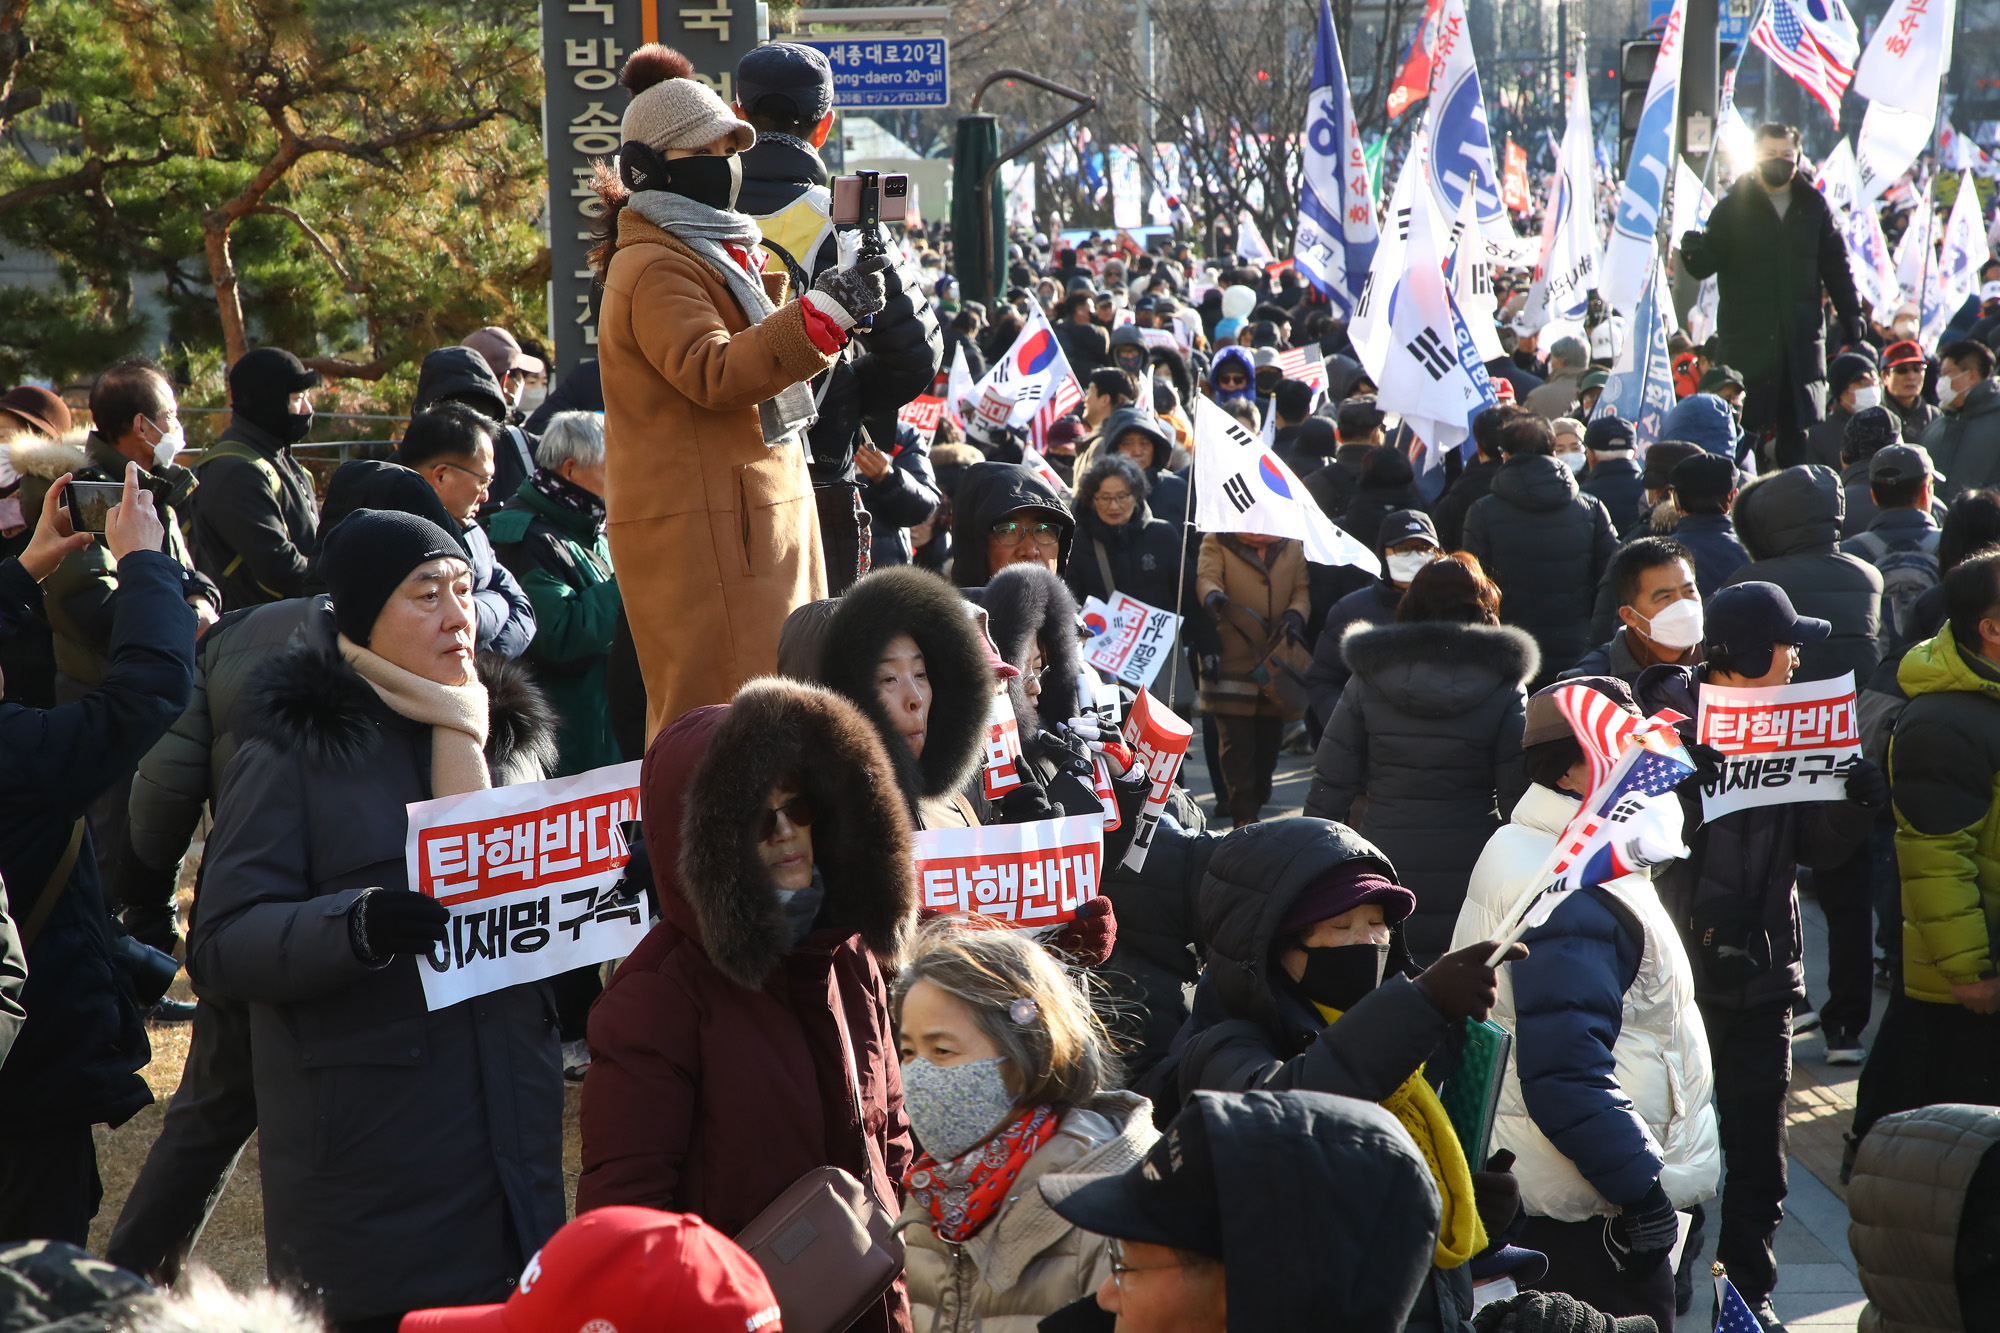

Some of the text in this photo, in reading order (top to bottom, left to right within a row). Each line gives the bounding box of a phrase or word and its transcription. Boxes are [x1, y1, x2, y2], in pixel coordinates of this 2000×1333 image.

[829, 43, 942, 66] 세종대로20길
[832, 69, 943, 87] ong-daero 20-gil
[1123, 613, 1172, 681] 이재명 구속
[1709, 698, 1859, 750] 탄핵반대
[1703, 757, 1796, 798] 이재명
[427, 799, 632, 898] 탄핵반대
[923, 853, 1097, 922] 탄핵반대
[424, 897, 550, 973] 이재명
